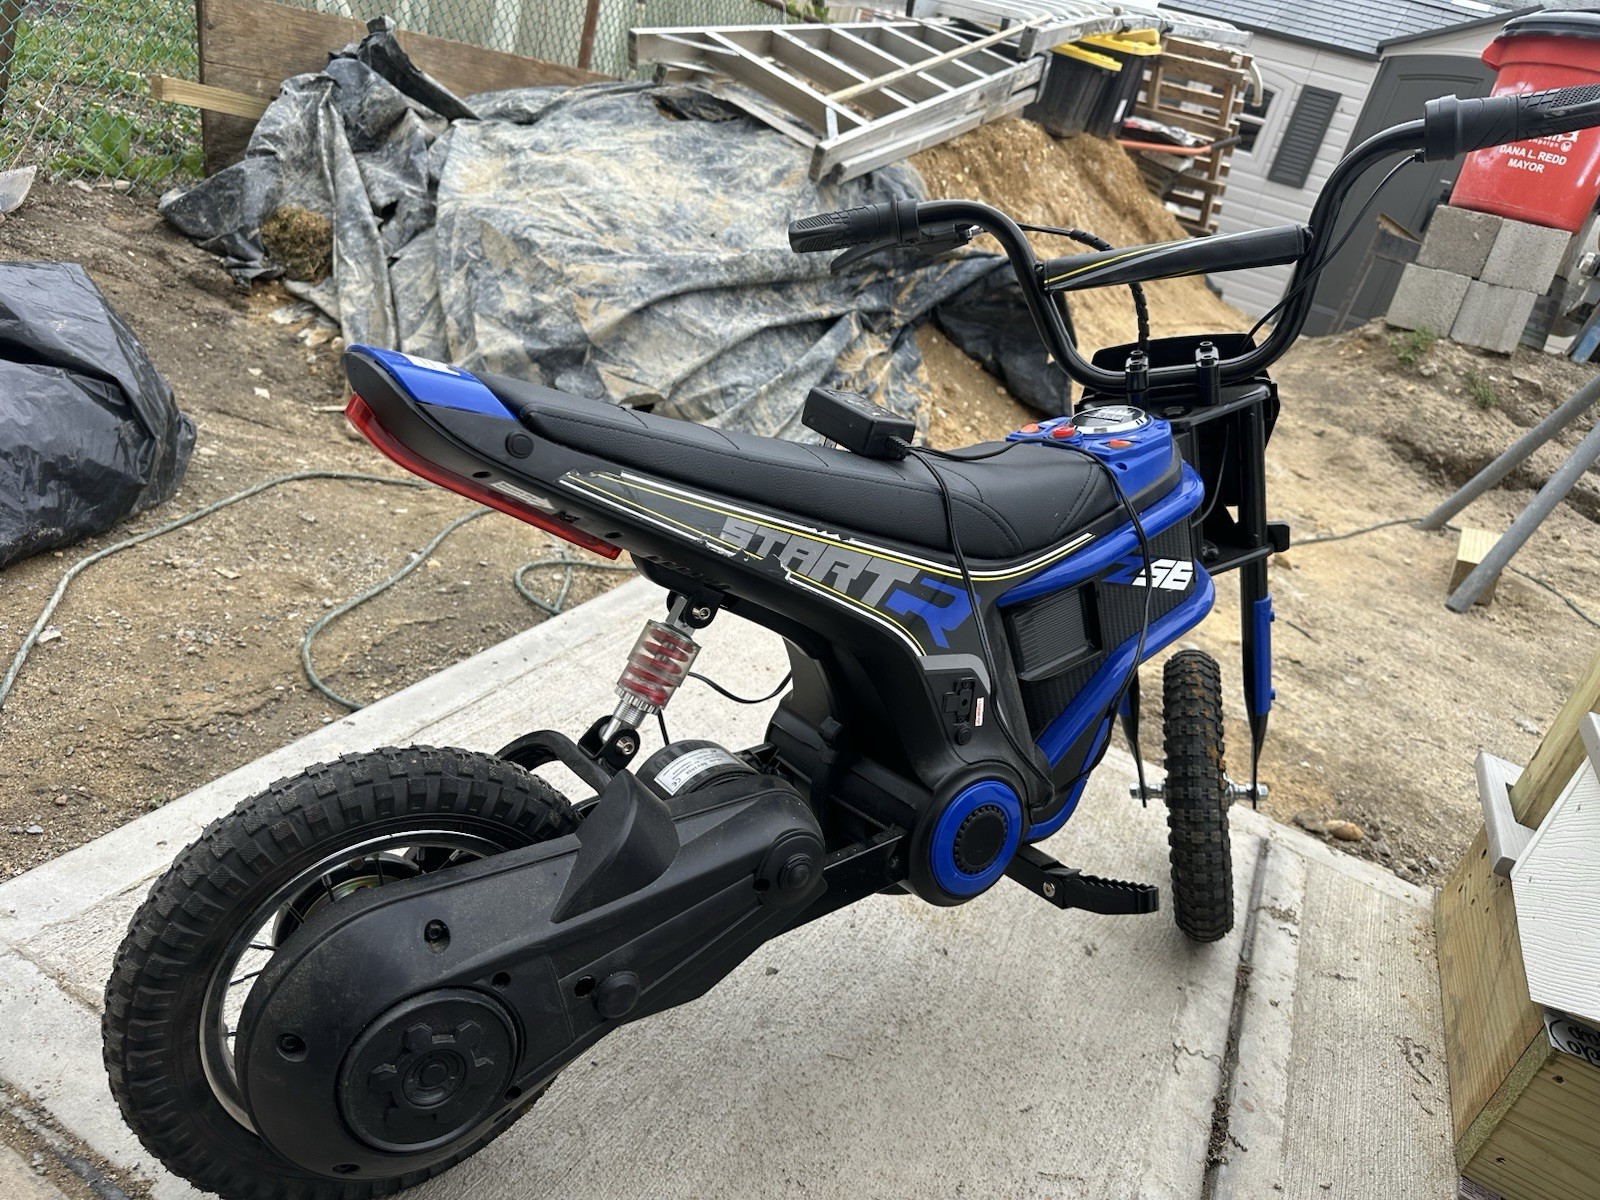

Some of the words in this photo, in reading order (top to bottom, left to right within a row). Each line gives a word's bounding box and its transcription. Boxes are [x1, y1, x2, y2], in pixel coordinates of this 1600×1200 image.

[1499, 145, 1526, 157] DANA
[1527, 149, 1536, 159] L.
[1537, 151, 1567, 165] REDD
[1507, 158, 1545, 173] MAYOR
